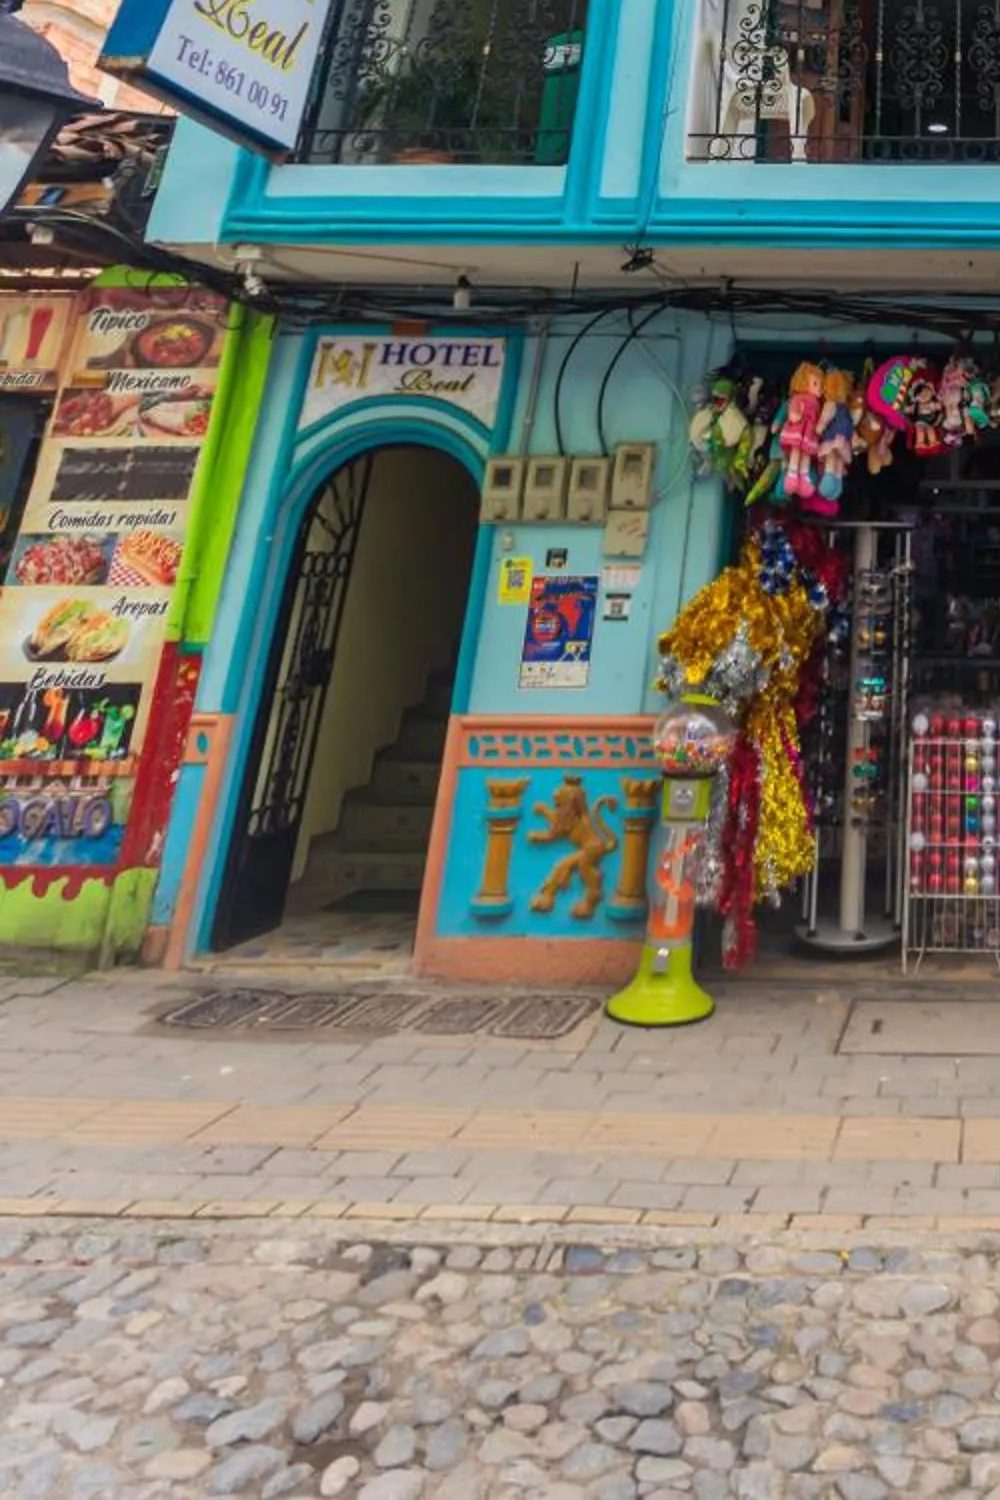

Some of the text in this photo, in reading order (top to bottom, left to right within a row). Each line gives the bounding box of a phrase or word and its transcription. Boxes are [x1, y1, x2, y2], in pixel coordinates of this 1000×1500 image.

[176, 34, 289, 122] Tel: 861 00 91
[379, 343, 500, 367] HOTEL
[107, 371, 191, 392] Mexicano
[393, 368, 475, 392] Real
[48, 509, 113, 530] Comidas
[112, 596, 169, 620] Arepas
[30, 667, 107, 689] Bebidas
